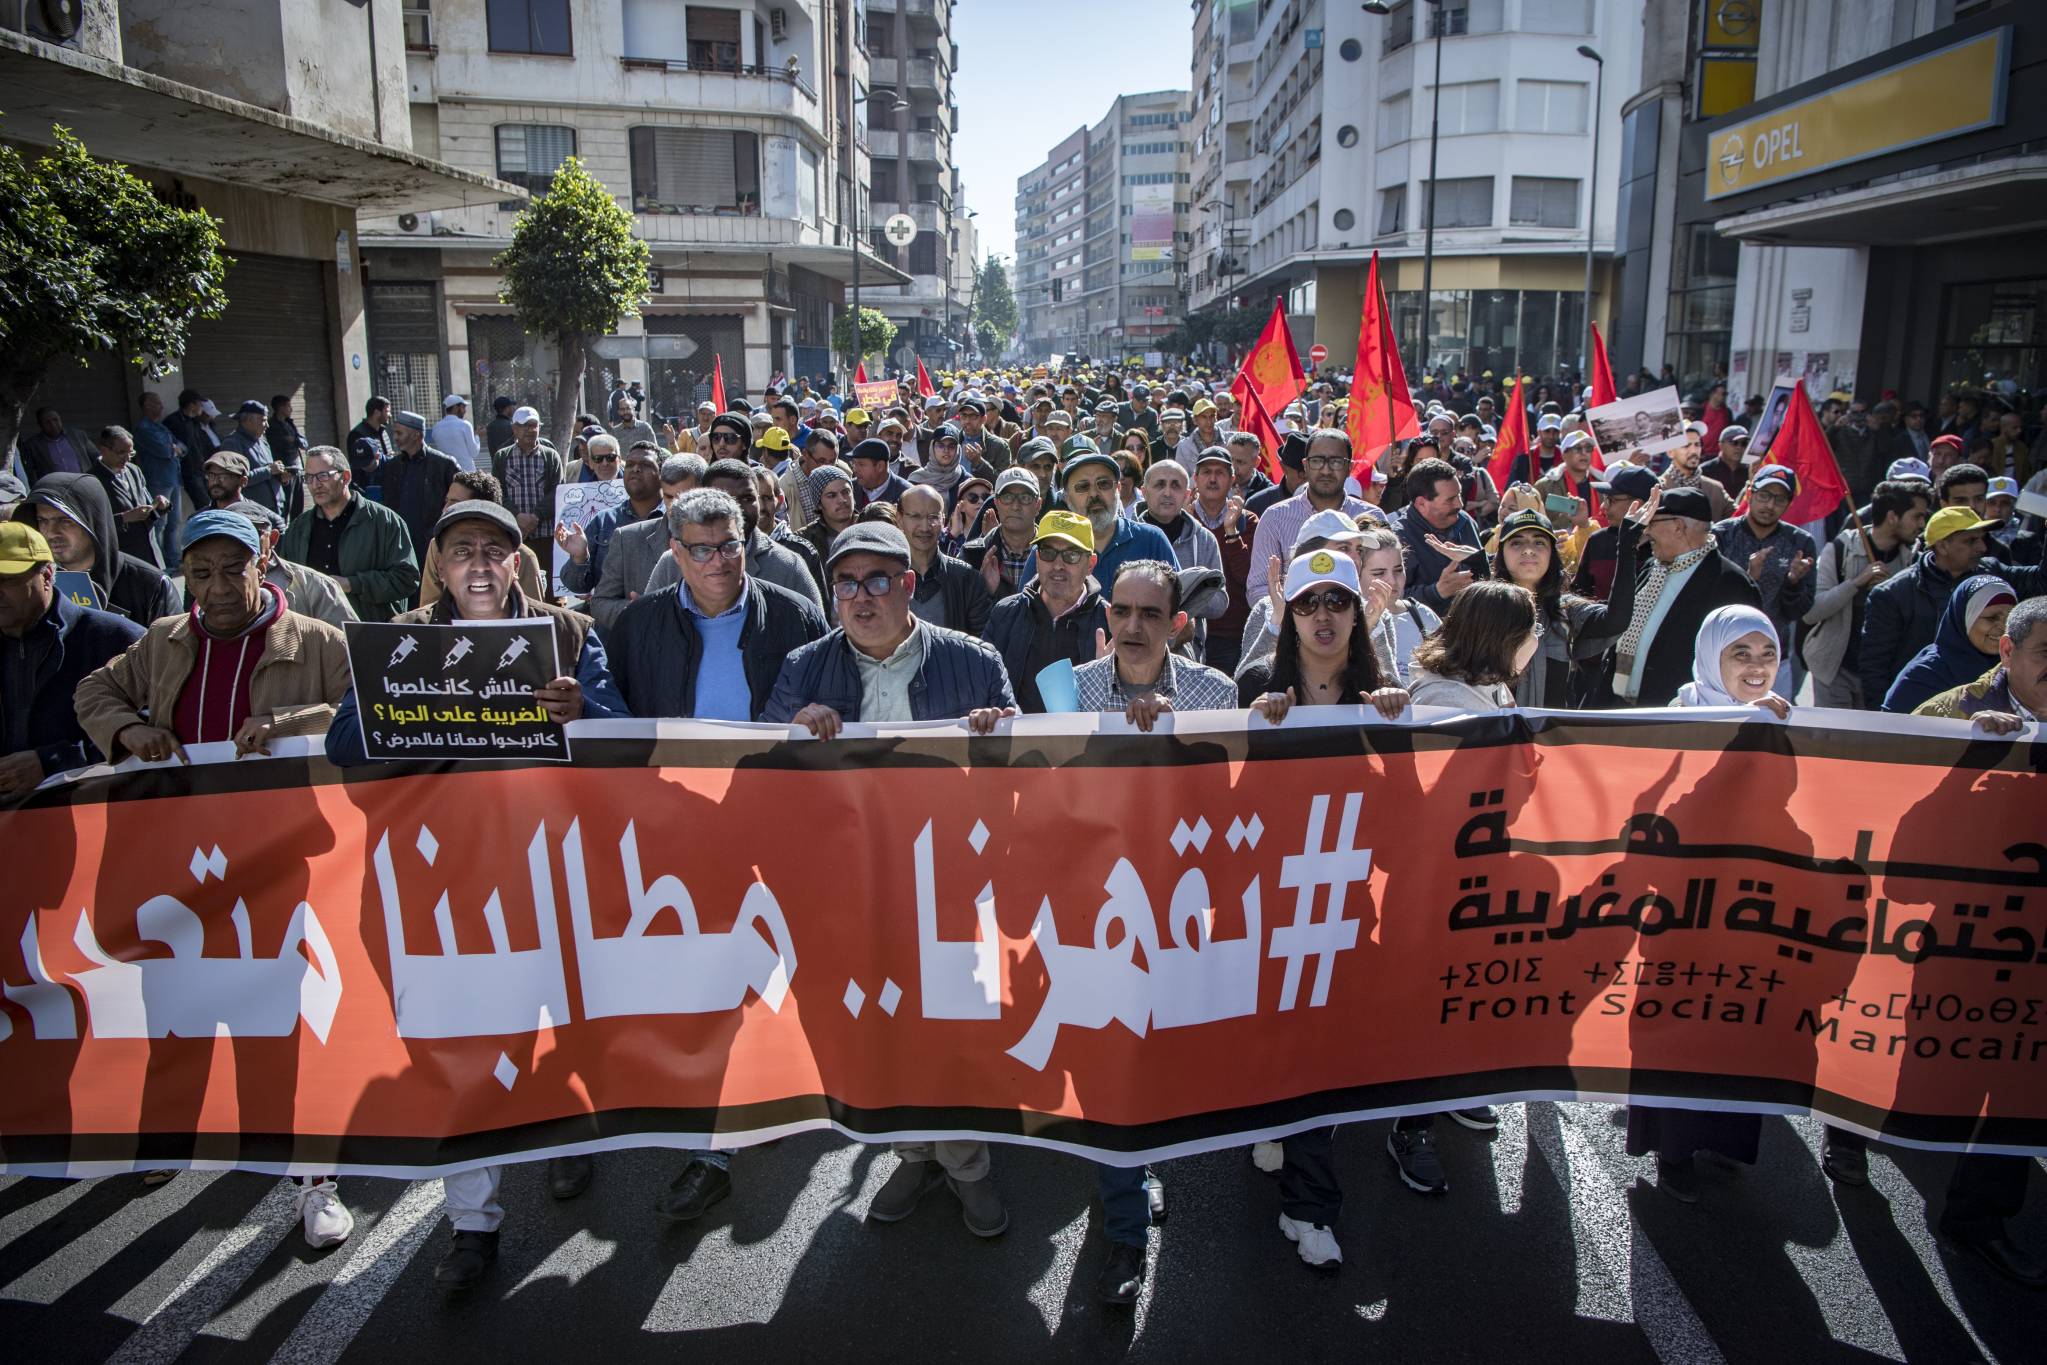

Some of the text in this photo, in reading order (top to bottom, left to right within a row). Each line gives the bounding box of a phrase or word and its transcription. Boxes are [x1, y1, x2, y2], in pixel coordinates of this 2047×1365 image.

[1753, 122, 1803, 169] OPEL
[383, 676, 534, 699] علاش كانخلصوا
[389, 704, 428, 725] الدوا
[434, 705, 477, 723] على
[482, 705, 548, 725] الضريبة
[386, 732, 443, 749] فالمرض
[448, 732, 487, 747] معانا
[491, 733, 559, 749] كاتربحوا
[1448, 873, 2047, 982] جتماعية المغربية
[0, 843, 343, 1047] متعدد
[373, 814, 798, 1092] مطالبنا
[1440, 990, 1576, 1024] Front
[1600, 992, 1767, 1025] Social
